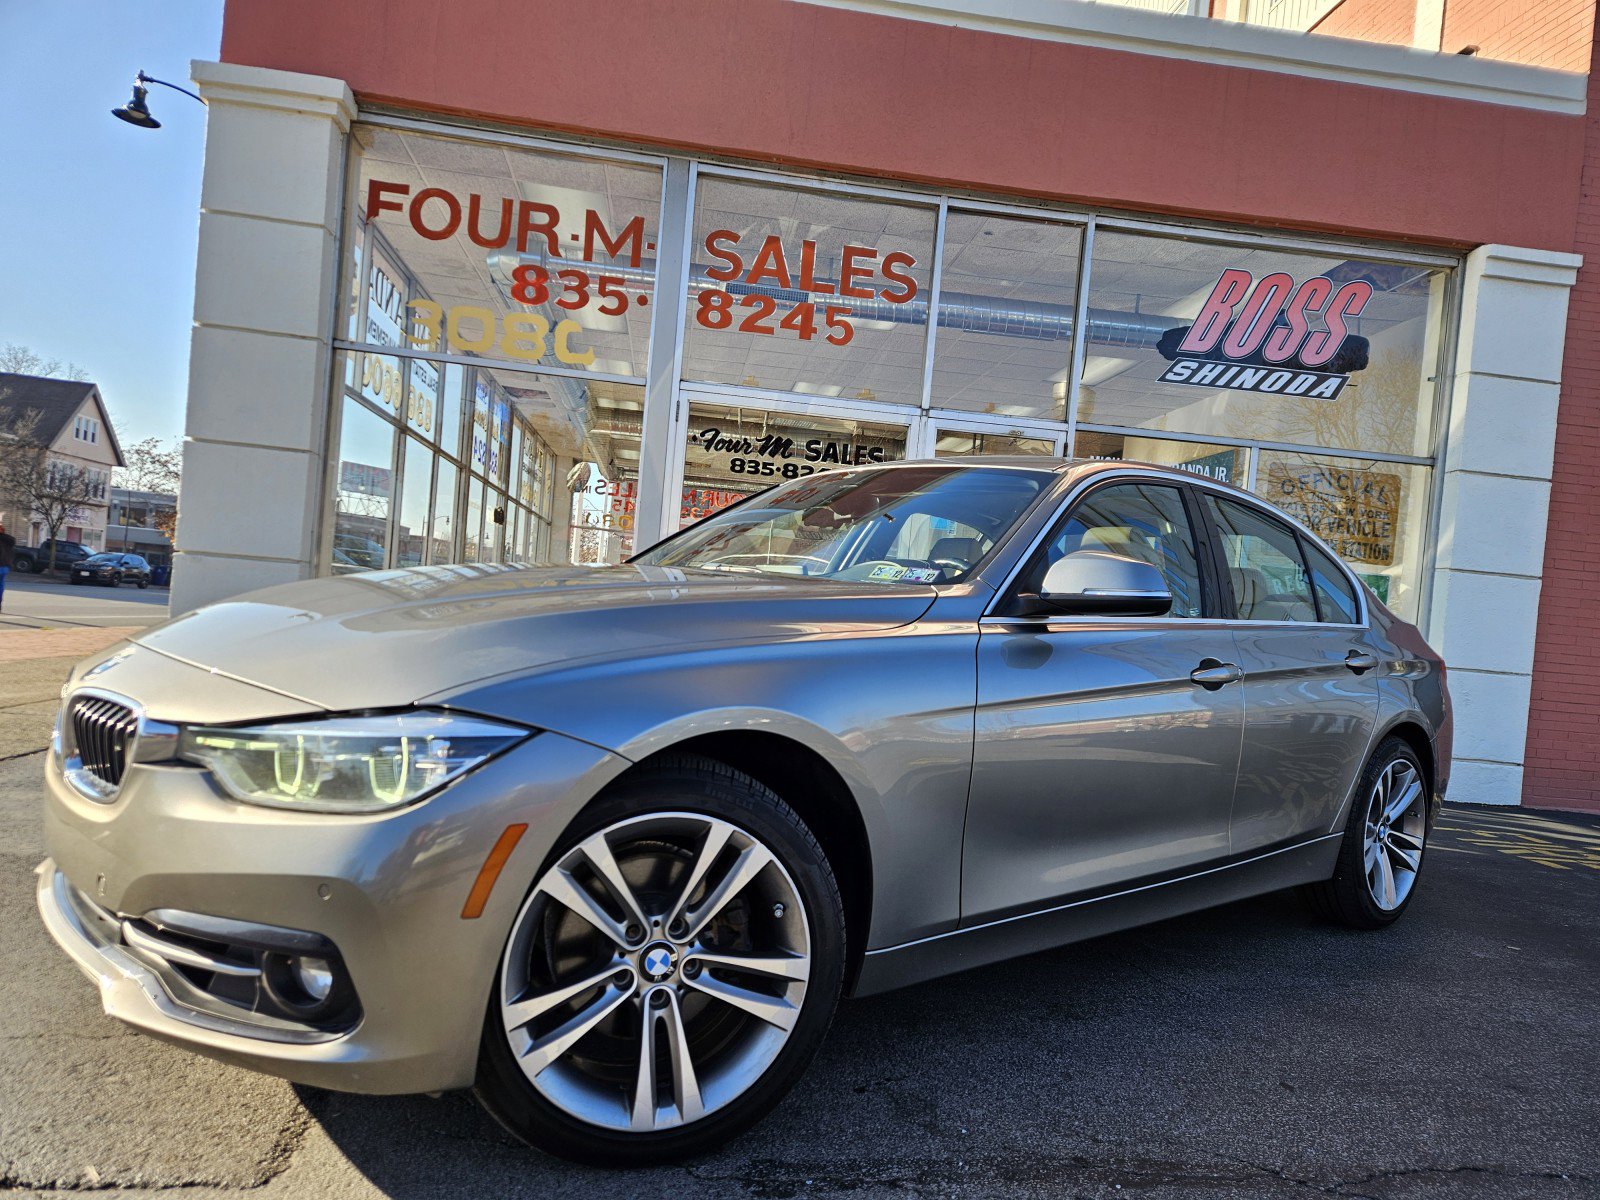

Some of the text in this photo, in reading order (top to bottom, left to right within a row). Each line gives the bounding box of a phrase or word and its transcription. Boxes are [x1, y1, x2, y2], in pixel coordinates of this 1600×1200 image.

[703, 229, 918, 304] SALES
[696, 289, 855, 346] 8245
[1176, 267, 1374, 367] BOSS
[1165, 361, 1343, 399] SHINODA
[700, 428, 885, 465] Four M SALES
[1280, 473, 1388, 505] OFFICIAL
[1328, 518, 1391, 538] VEHICLE
[1360, 509, 1390, 519] YORK
[1342, 540, 1391, 560] STATION
